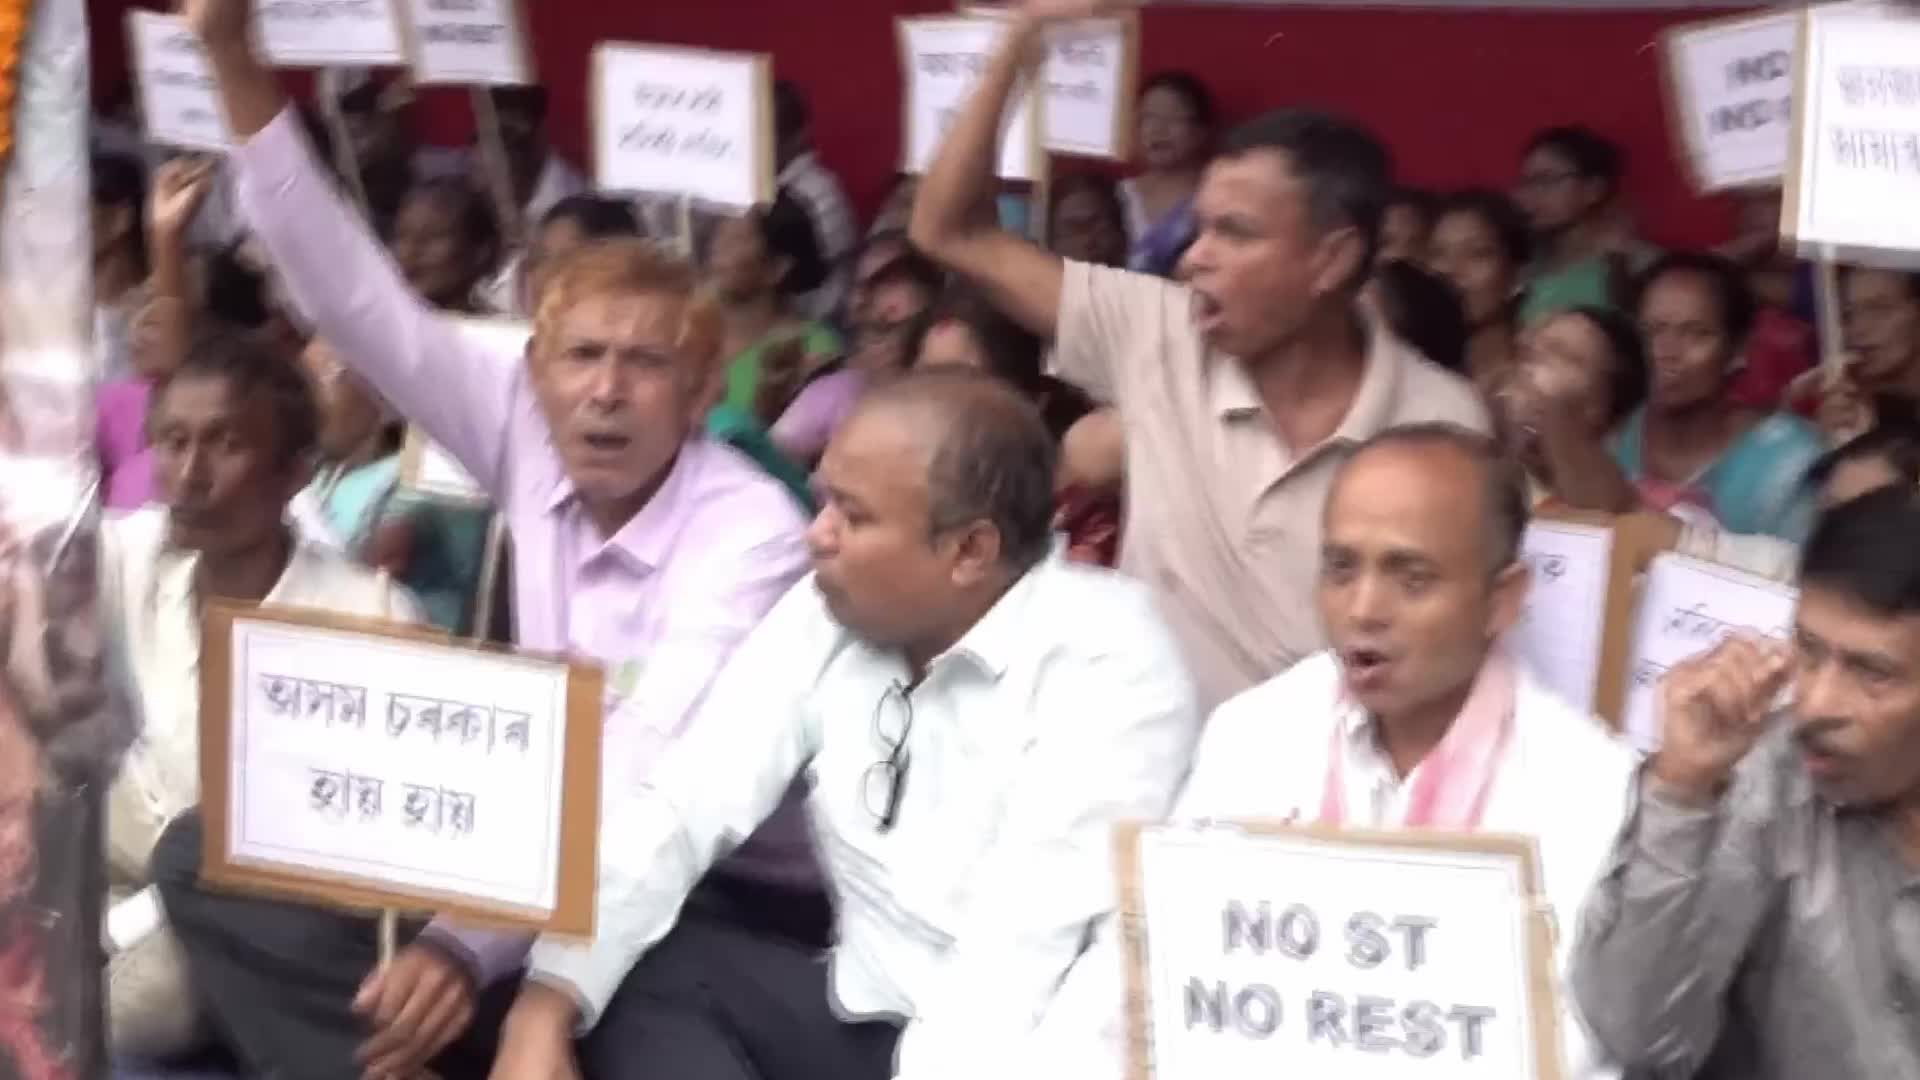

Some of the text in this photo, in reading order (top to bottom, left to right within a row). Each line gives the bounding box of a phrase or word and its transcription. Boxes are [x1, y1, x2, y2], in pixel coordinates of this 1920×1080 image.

[257, 672, 367, 729] অসম
[1222, 899, 1438, 971] NO ST
[1183, 976, 1496, 1061] NO REST
